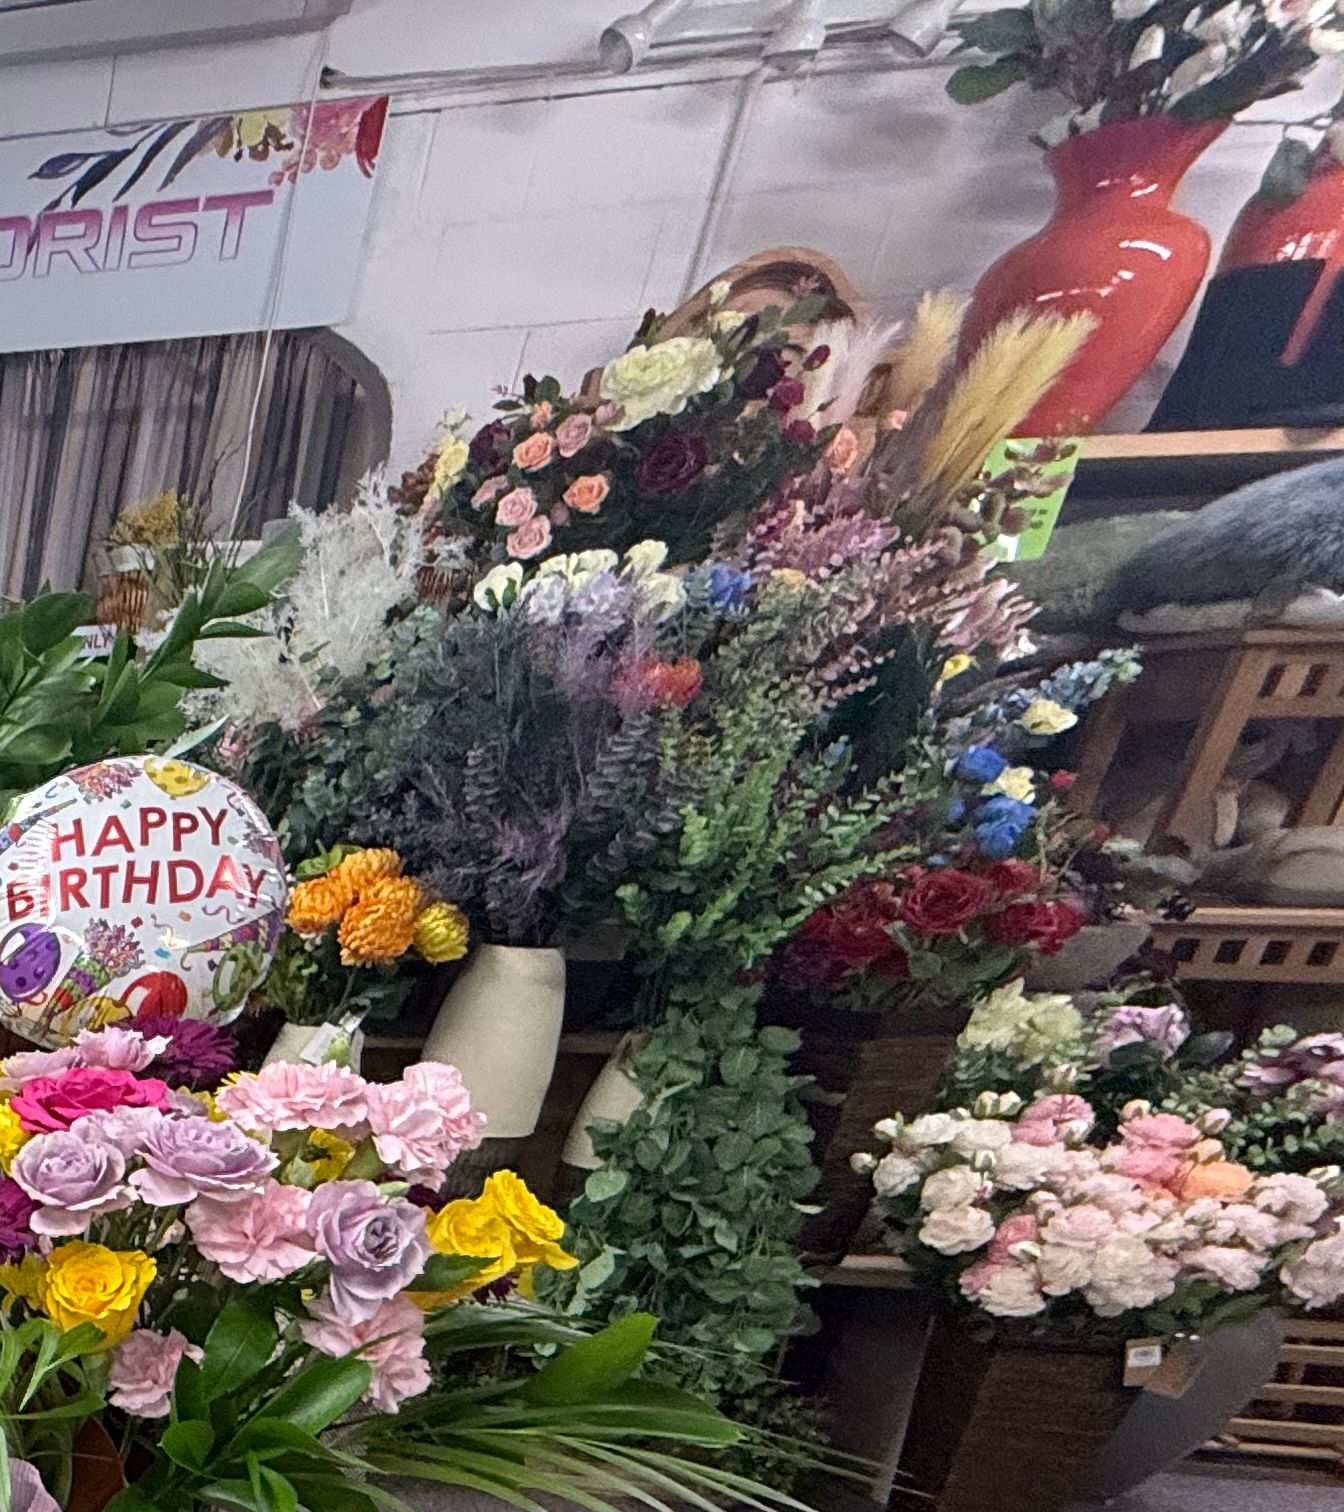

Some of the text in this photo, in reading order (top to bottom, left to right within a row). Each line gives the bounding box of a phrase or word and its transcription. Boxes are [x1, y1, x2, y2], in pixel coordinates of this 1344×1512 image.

[81, 630, 114, 649] NLY
[49, 805, 228, 863] HAPPY
[6, 854, 267, 921] BIRTHDAY
